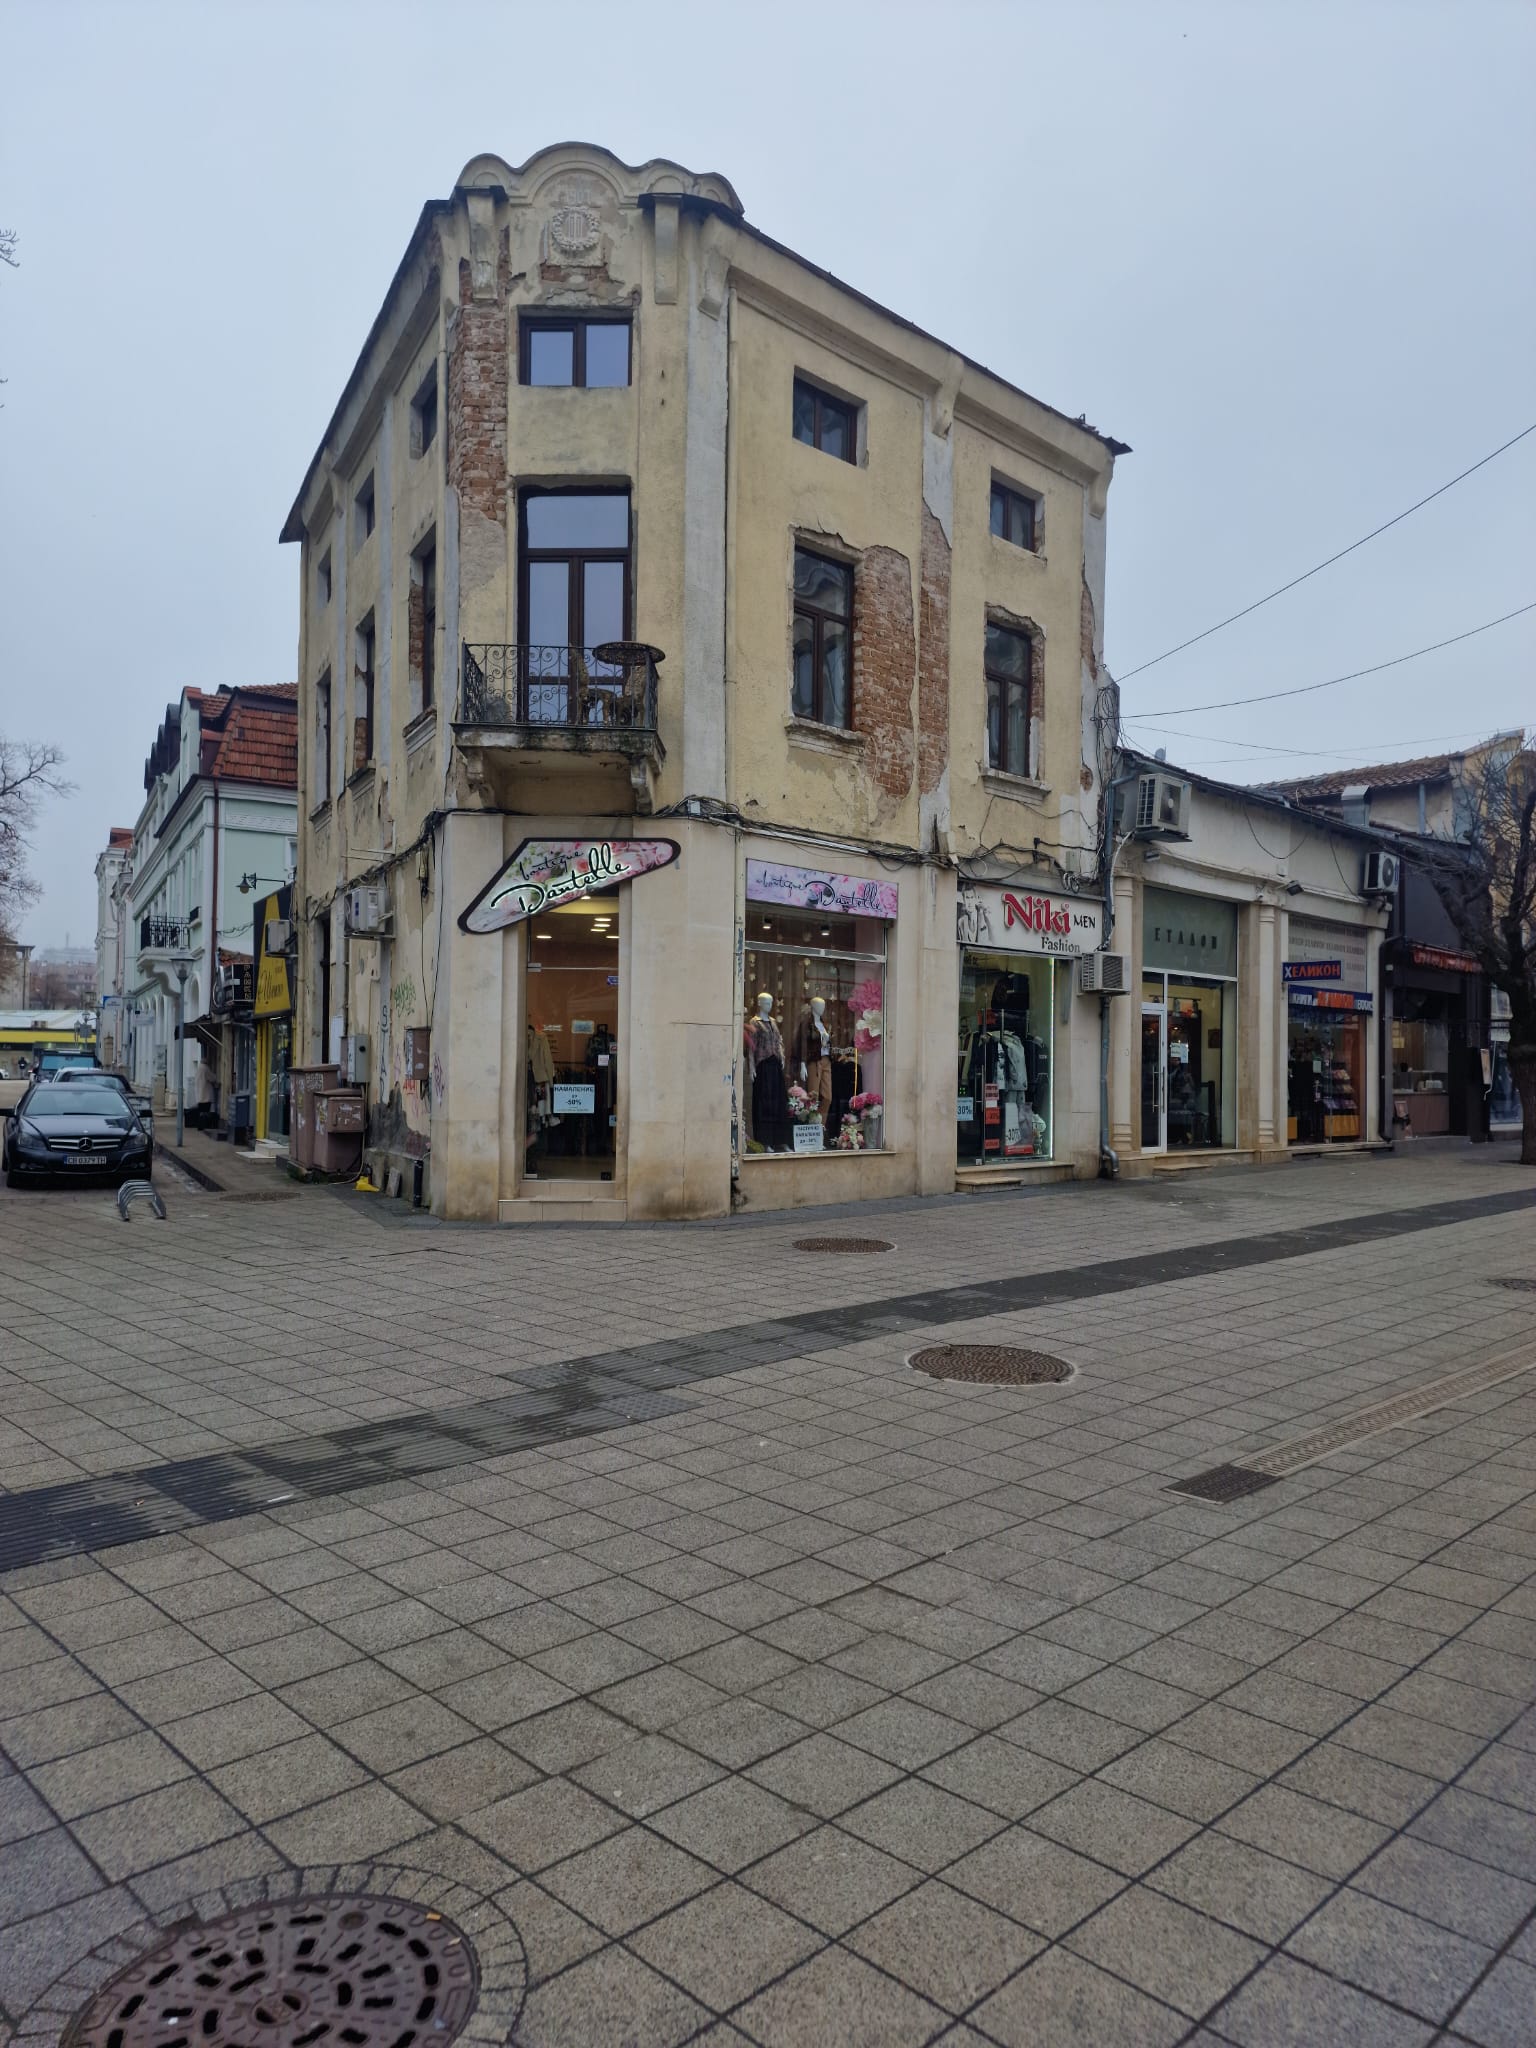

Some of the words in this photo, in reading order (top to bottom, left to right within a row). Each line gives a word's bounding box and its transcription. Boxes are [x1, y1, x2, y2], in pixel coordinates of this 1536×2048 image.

[491, 843, 629, 913] Dantelle
[519, 850, 584, 881] boutique
[757, 870, 804, 897] boutique
[805, 881, 881, 911] Dantelle
[1003, 892, 1070, 934] Niki
[1073, 914, 1096, 928] MEN
[1041, 936, 1080, 953] Fashion
[1284, 964, 1340, 978] ХЕЛИКОН
